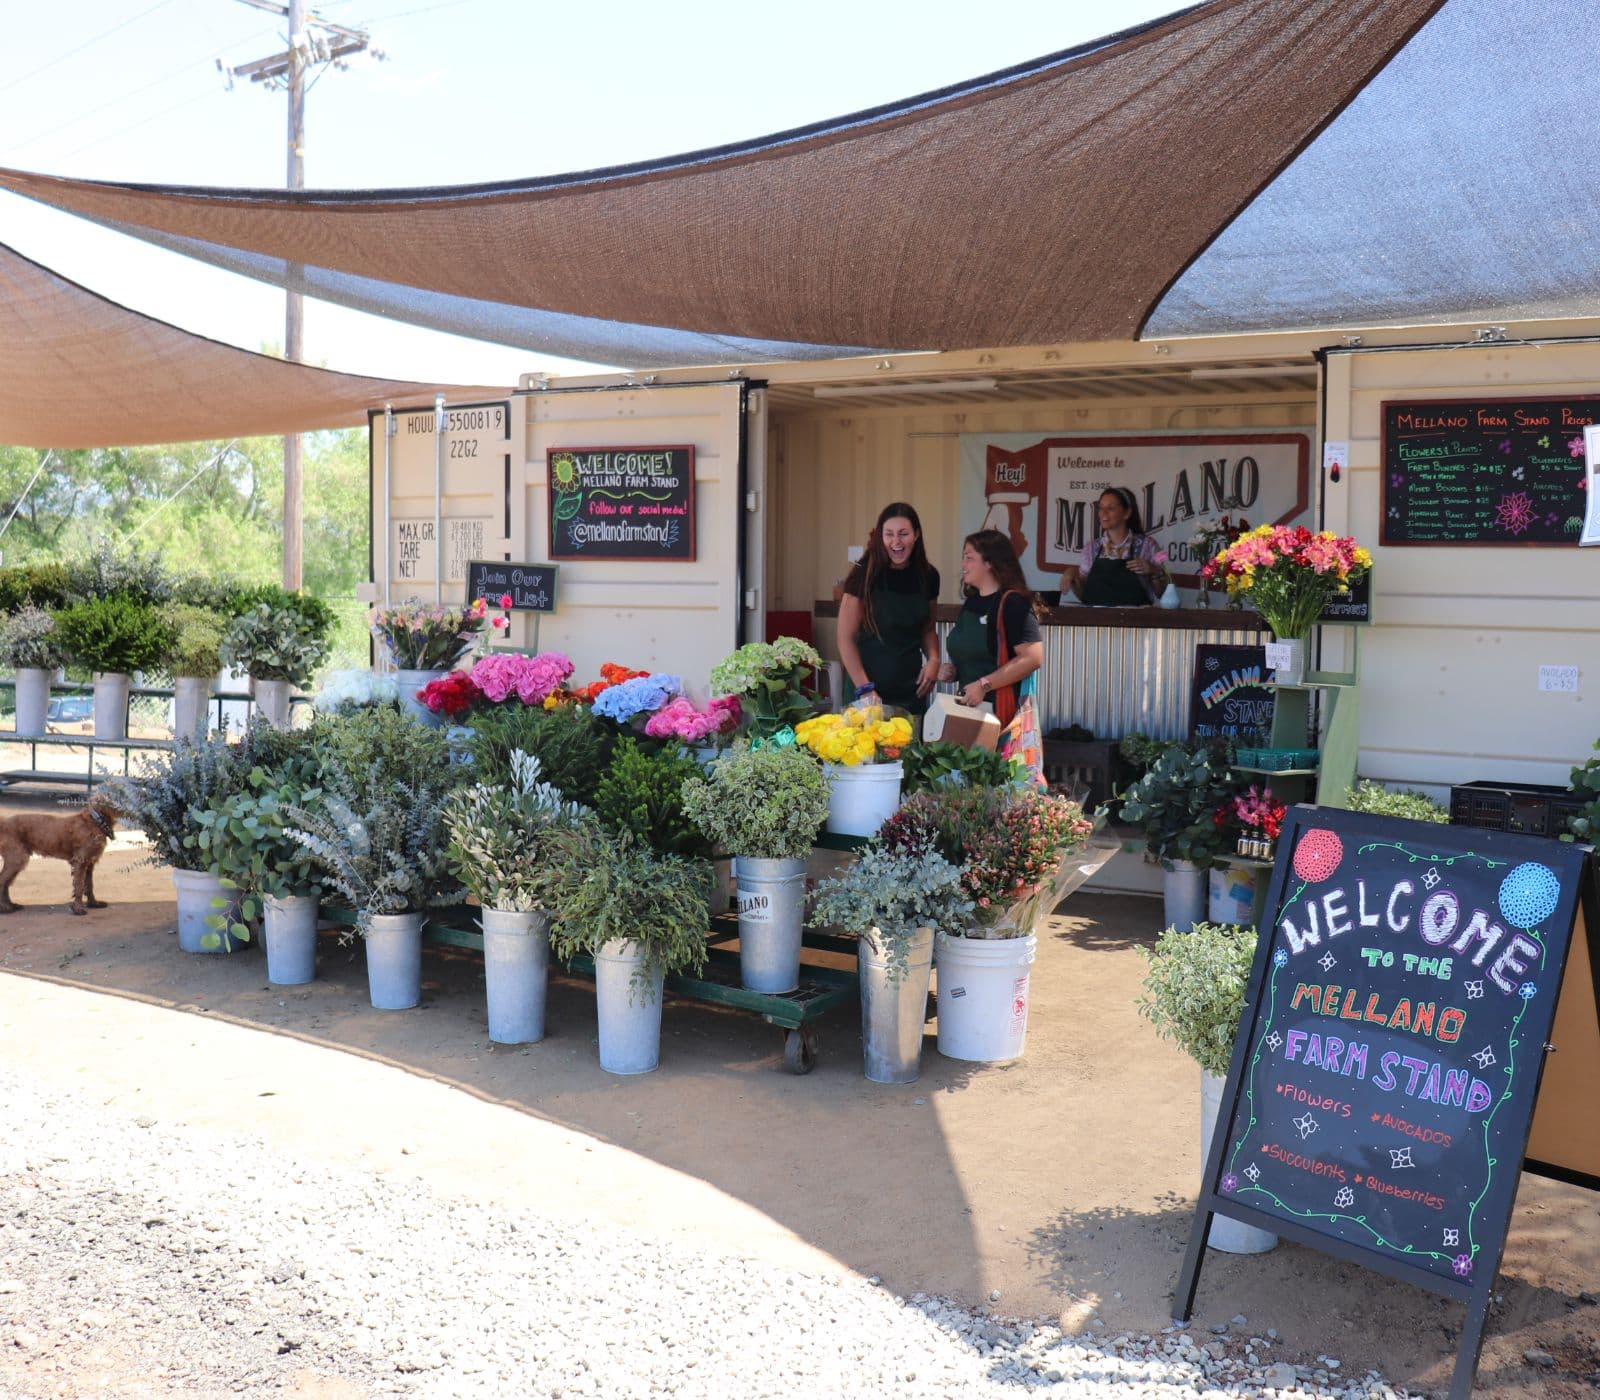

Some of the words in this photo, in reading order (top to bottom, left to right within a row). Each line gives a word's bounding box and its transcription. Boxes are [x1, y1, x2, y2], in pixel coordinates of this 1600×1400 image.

[408, 415, 434, 434] HOUU
[450, 411, 490, 431] 550081
[495, 410, 502, 428] 9
[1397, 414, 1468, 429] MELLANO
[1477, 408, 1508, 427] FARM
[1513, 409, 1550, 426] STAND
[1561, 408, 1593, 425] PRICES
[450, 439, 478, 458] 22G2
[1399, 443, 1443, 458] FLOWERS
[575, 451, 674, 476] WELCOME!
[1057, 456, 1111, 469] Welcome
[1114, 457, 1126, 469] to
[583, 475, 622, 488] MELLANO
[625, 475, 649, 488] FARM
[651, 475, 680, 488] STAND
[996, 463, 1026, 486] Hey!
[1069, 481, 1088, 490] EST.
[589, 501, 617, 515] follow
[619, 505, 633, 515] our
[638, 503, 660, 515] social
[662, 500, 688, 515] media!
[574, 519, 670, 543] @mellanofarmstand
[399, 542, 421, 559] TARE
[399, 560, 417, 578] NET
[477, 566, 506, 585] Join
[512, 569, 542, 586] Our
[515, 587, 548, 607] List
[1281, 879, 1542, 995] WELCOME
[1361, 948, 1394, 968] TO
[1403, 953, 1453, 981] THE
[1290, 982, 1467, 1044] MELLANO
[1284, 1029, 1369, 1080] FARM
[1372, 1051, 1492, 1113] STAND
[1268, 1143, 1347, 1183] Succulents
[1366, 1176, 1446, 1211] Blueberries
